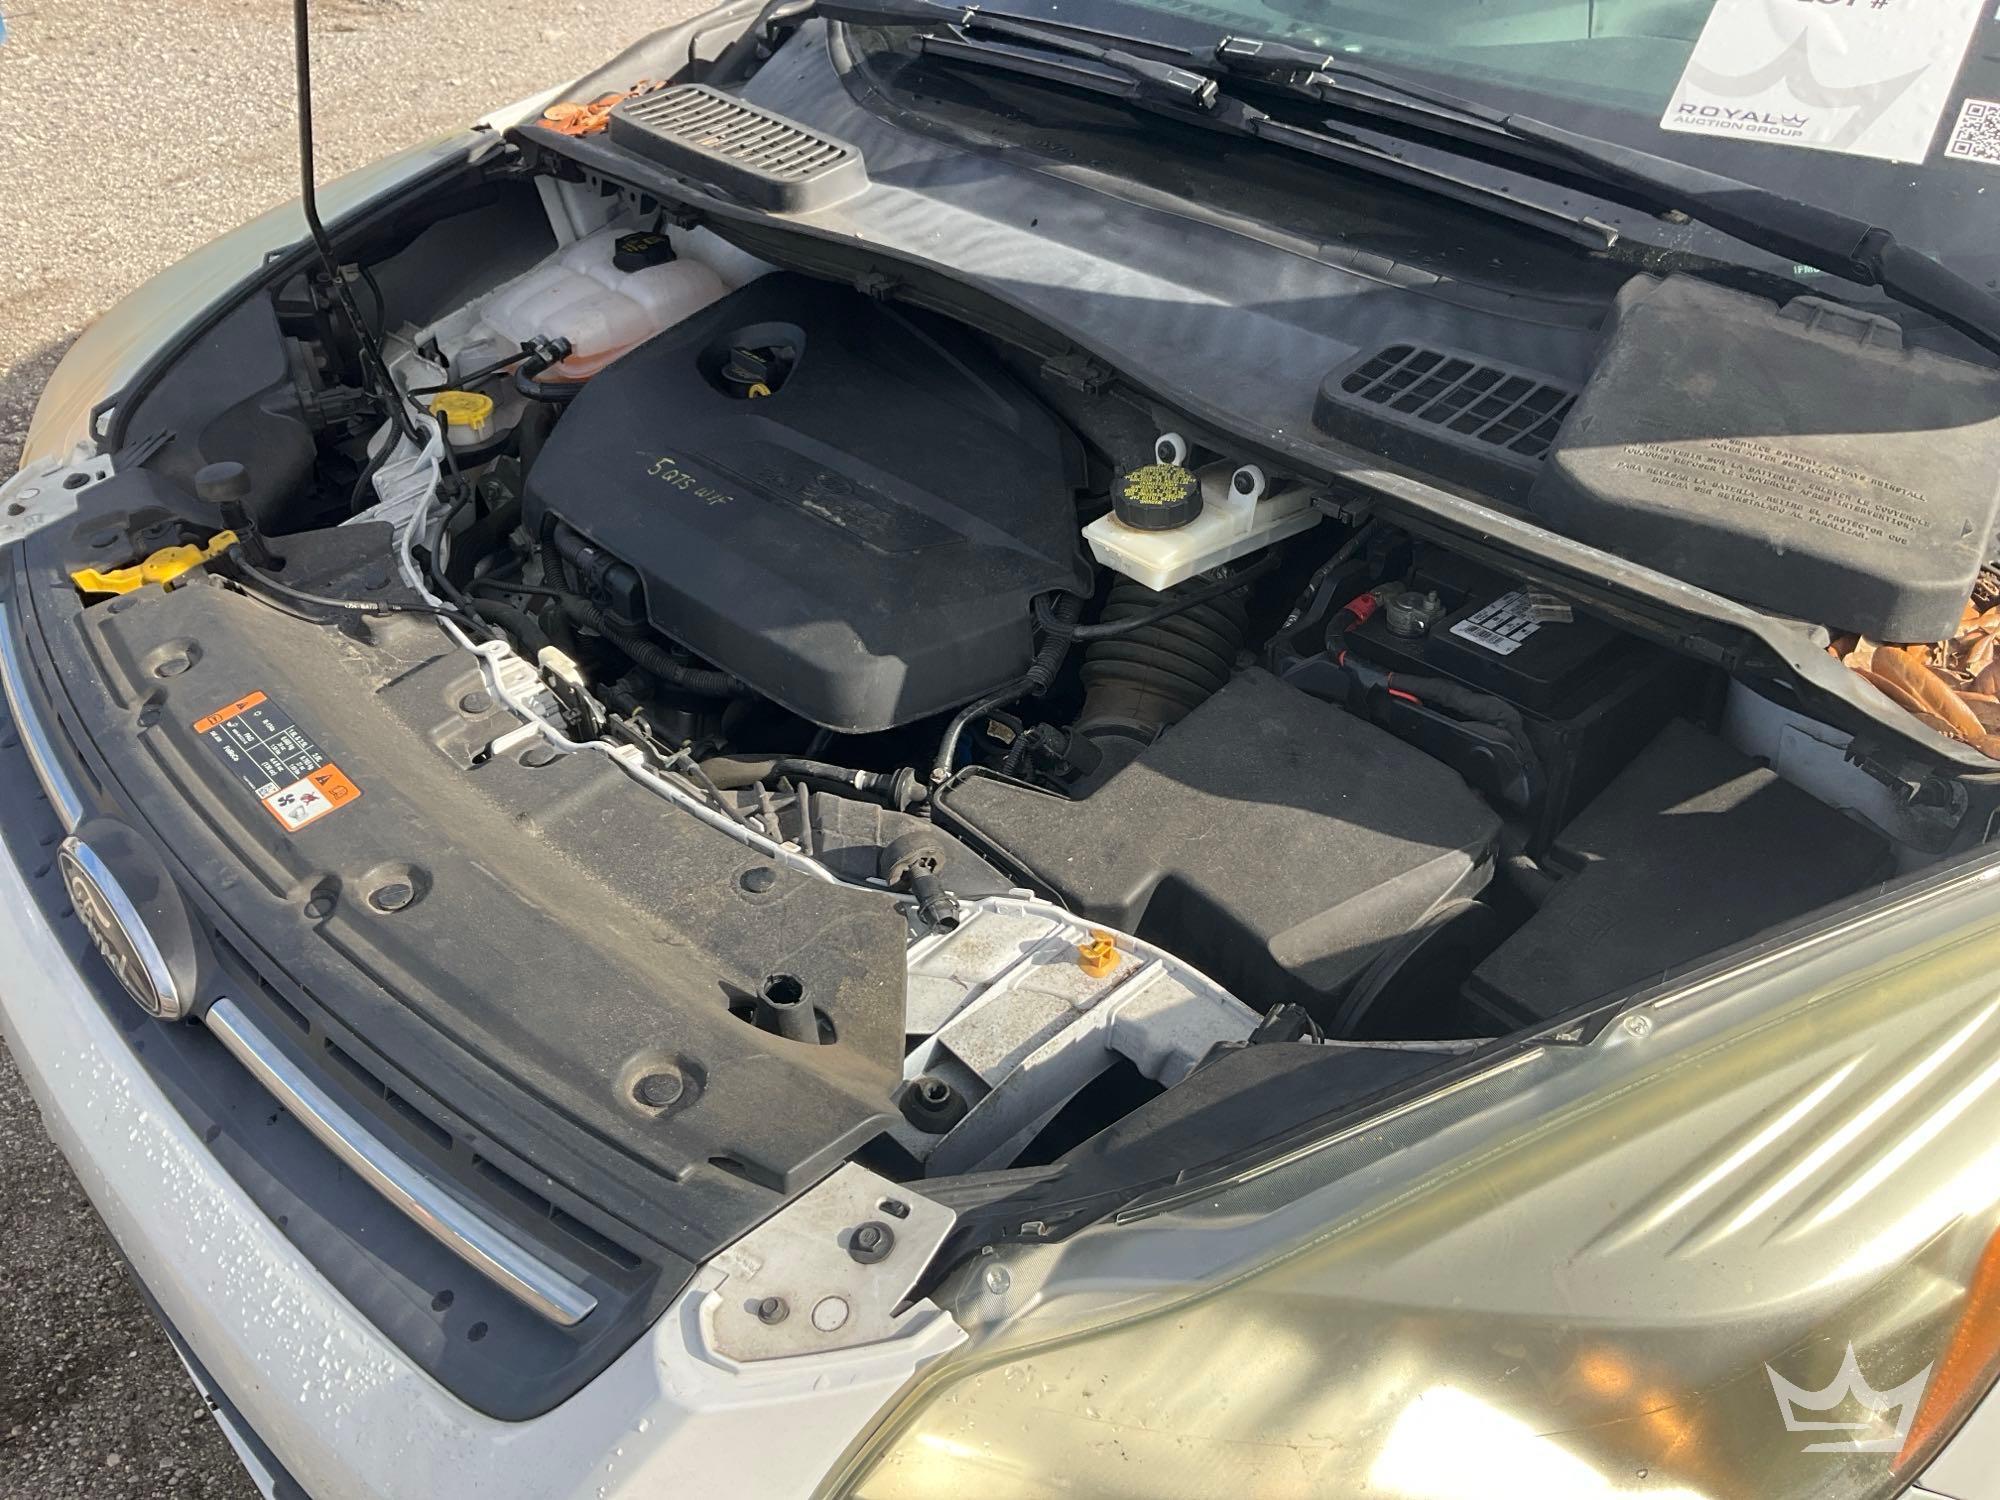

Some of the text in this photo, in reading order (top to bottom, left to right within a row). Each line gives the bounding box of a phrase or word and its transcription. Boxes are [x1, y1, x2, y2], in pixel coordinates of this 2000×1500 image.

[1674, 116, 1803, 137] AUCTION GROUP
[1679, 103, 1777, 125] ROYAL
[647, 457, 676, 475] 5
[1711, 442, 1741, 455] COVER
[1745, 451, 1777, 464] AFTER
[1728, 438, 1771, 453] SERVICE
[1829, 465, 1867, 481] ALWAYS
[1870, 478, 1927, 502] REINSTALL
[1674, 457, 1717, 472] REPOSER
[1721, 468, 1735, 476] LE
[1739, 472, 1796, 492] COUVERCLE
[1707, 457, 1726, 466] SUR
[1731, 462, 1744, 470] LA
[1808, 482, 1852, 501] ENLEVER
[1857, 497, 1871, 507] LE
[1875, 504, 1931, 527] COUVERCLE
[1616, 461, 1643, 472] PARA
[1693, 477, 1707, 486] LA
[1808, 507, 1821, 516] EL
[1826, 513, 1884, 537] PROTECTOR
[1693, 486, 1713, 495] SER
[1717, 491, 1786, 515] REINSTALADO
[1790, 510, 1804, 521] AL
